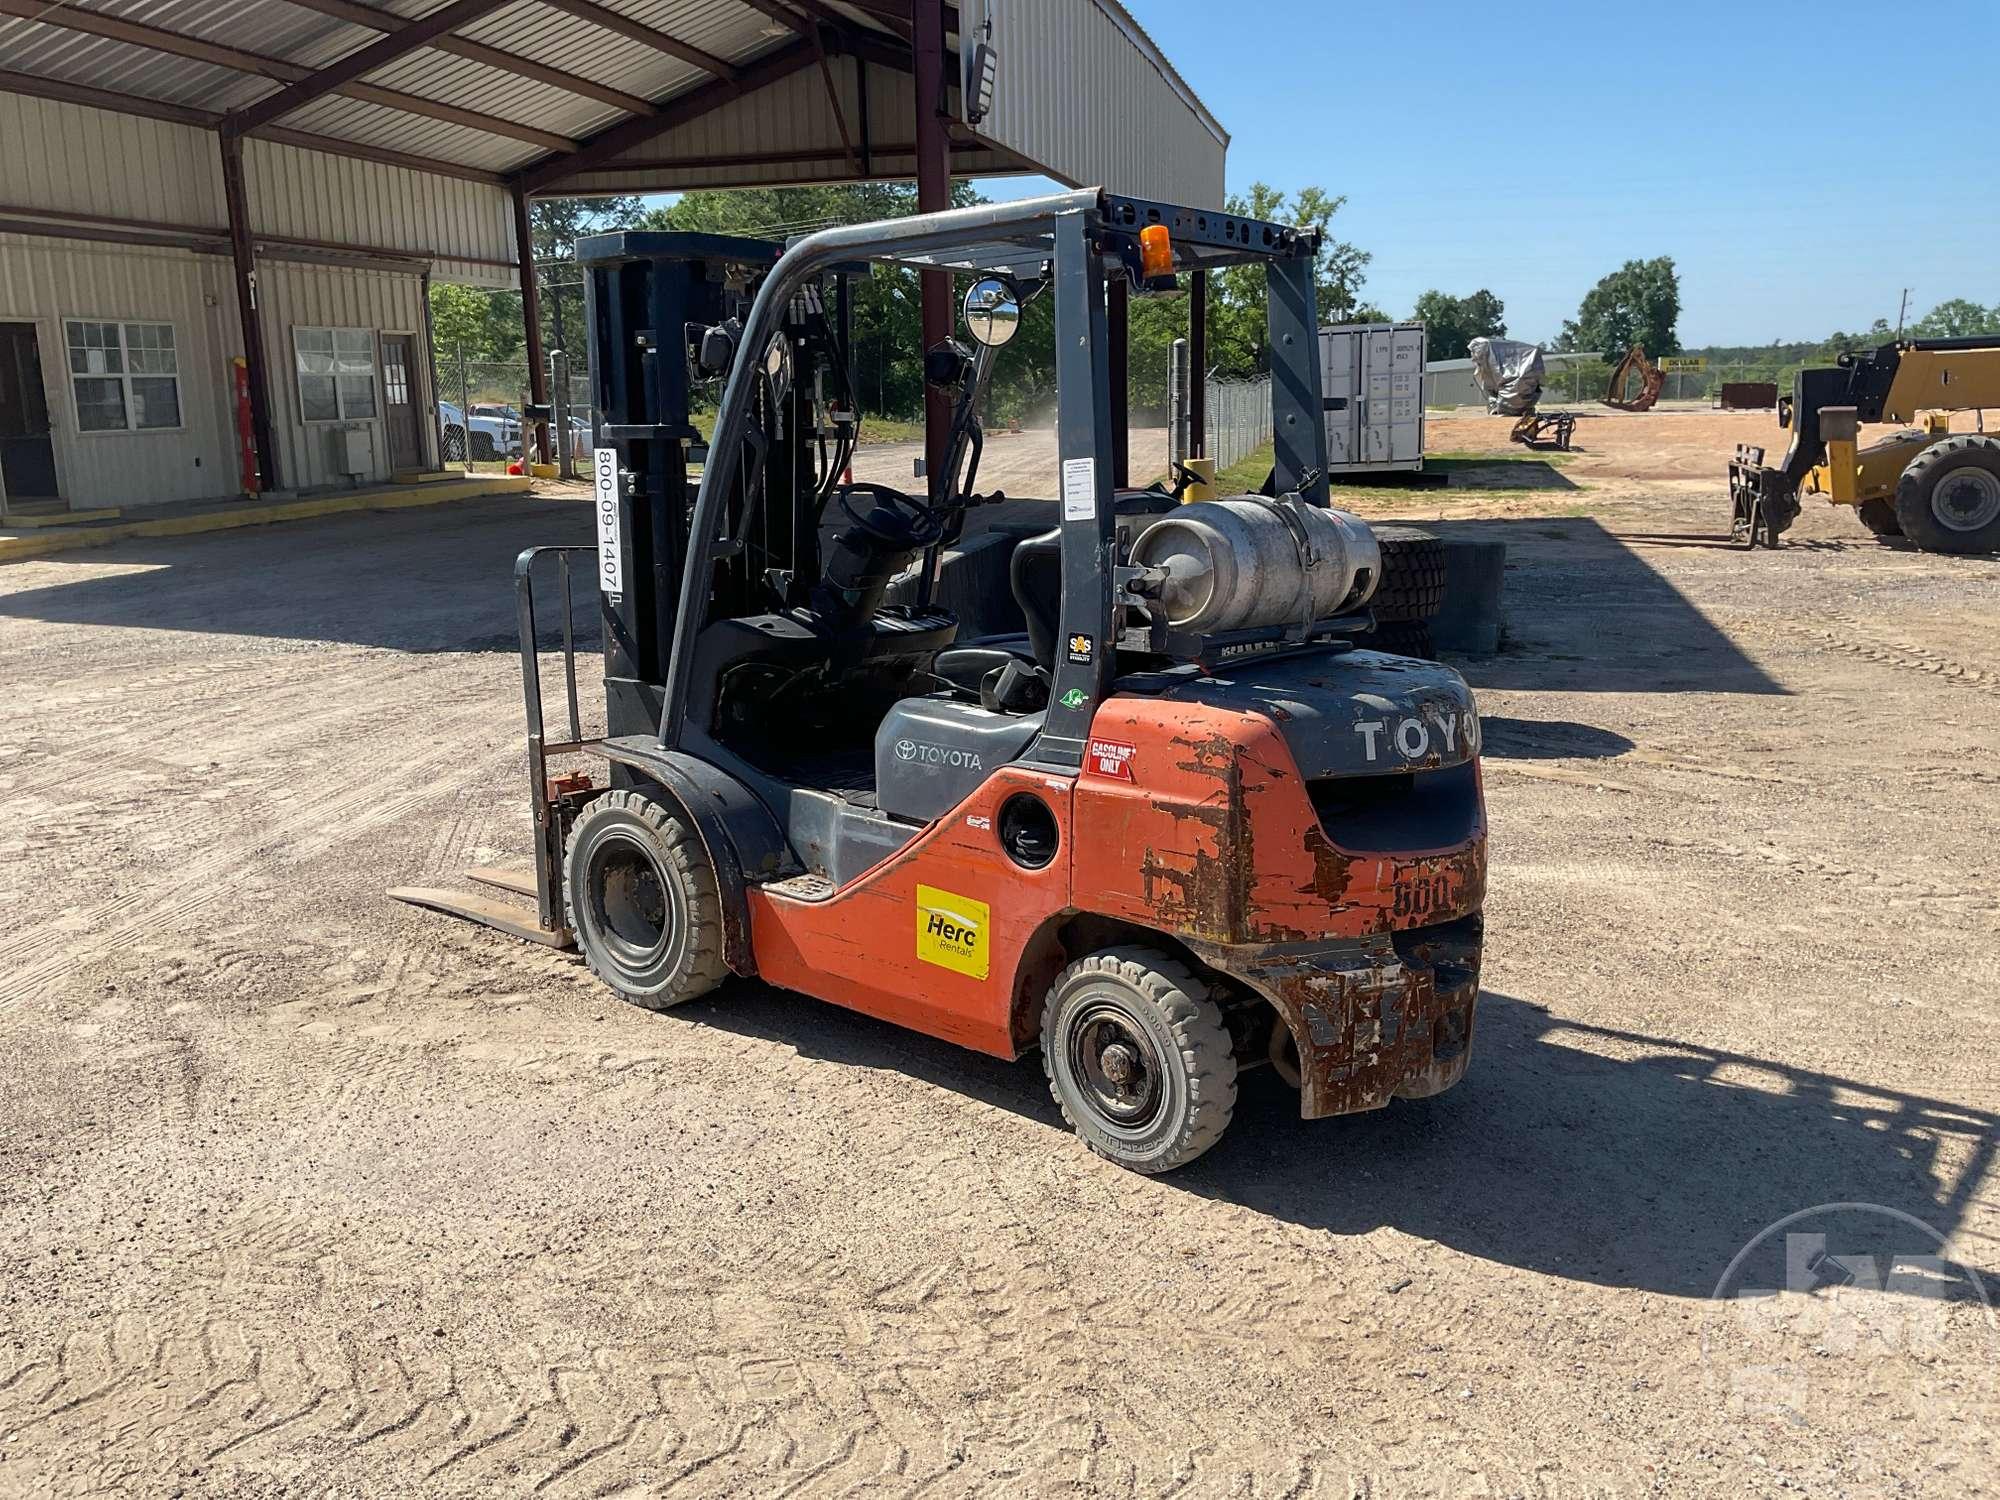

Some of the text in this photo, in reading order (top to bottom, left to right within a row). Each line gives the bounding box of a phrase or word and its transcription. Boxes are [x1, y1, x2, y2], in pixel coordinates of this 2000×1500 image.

[599, 451, 616, 587] 800-09-1407
[919, 745, 982, 770] TOYOTA
[1100, 758, 1120, 774] ONLY
[927, 913, 976, 947] Herc
[939, 940, 974, 958] Rentals
